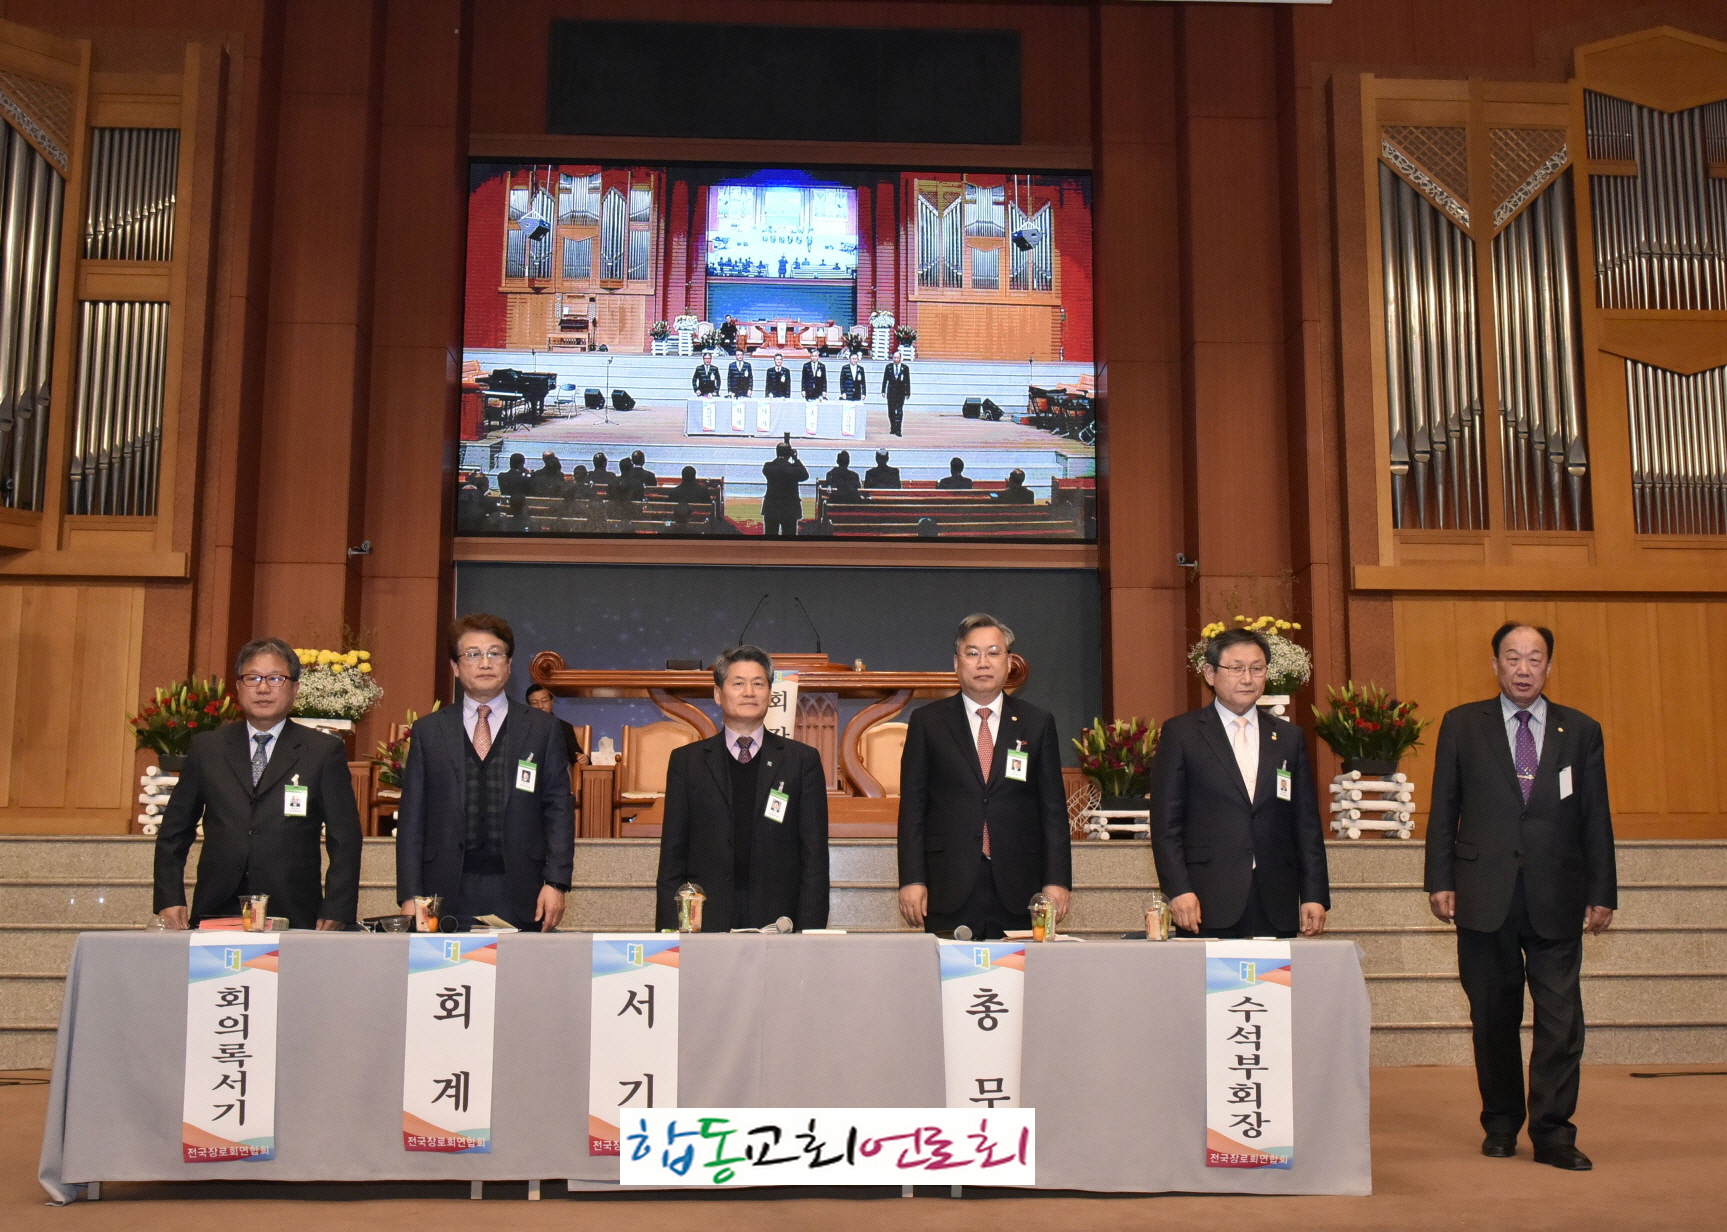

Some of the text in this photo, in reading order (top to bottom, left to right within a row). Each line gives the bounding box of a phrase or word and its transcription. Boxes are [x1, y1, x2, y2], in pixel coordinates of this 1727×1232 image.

[211, 985, 253, 1126] 회의록서기
[1226, 996, 1271, 1139] 수석부회장
[406, 1136, 486, 1148] 전국장로회연합회
[187, 1145, 270, 1158] 전국장로회연합회
[1210, 1153, 1288, 1165] 전국장로회연합회
